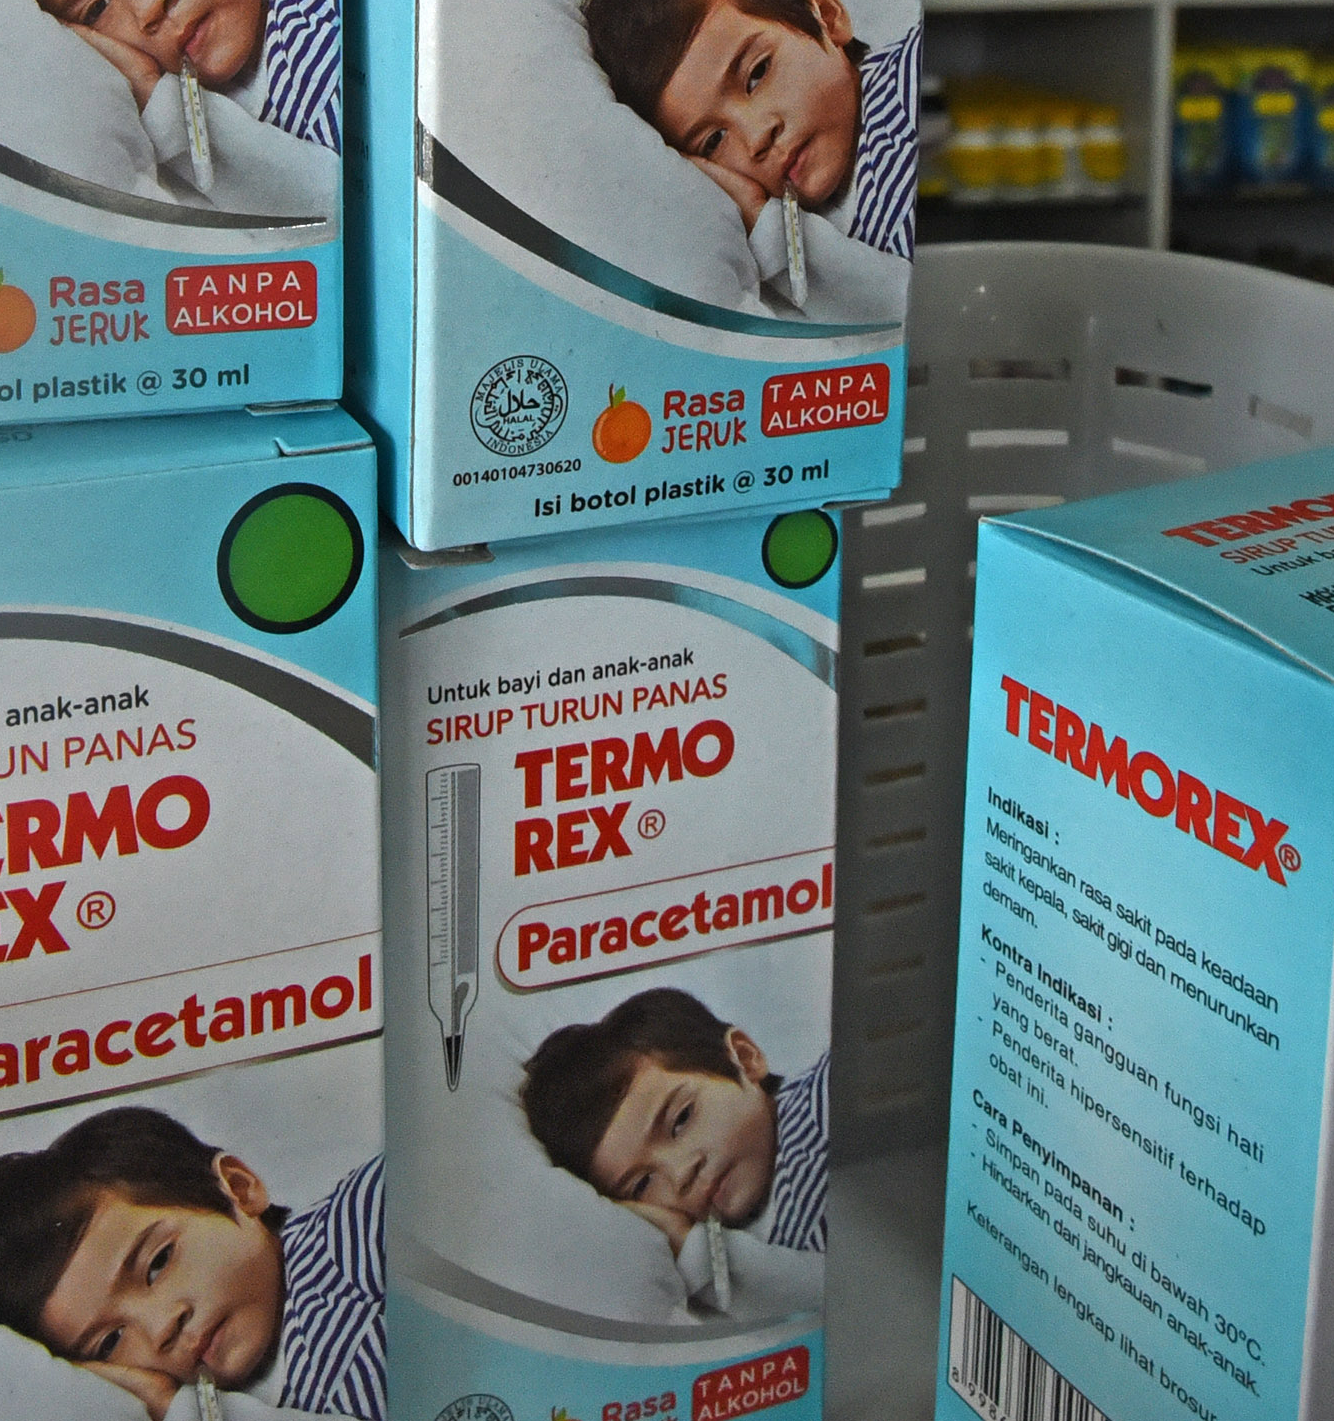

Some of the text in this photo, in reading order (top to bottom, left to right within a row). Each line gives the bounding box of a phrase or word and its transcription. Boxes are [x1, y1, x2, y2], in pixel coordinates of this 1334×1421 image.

[49, 276, 145, 308] Rasa
[173, 270, 301, 296] TANPA
[49, 309, 150, 346] JERUK
[173, 300, 312, 327] ALKOHOL
[33, 372, 126, 403] plastik
[136, 370, 162, 396] @
[172, 367, 207, 389] 30
[217, 363, 249, 387] ml
[475, 358, 564, 402] MAJELIS ULAMA
[769, 372, 876, 402] TANPA
[502, 414, 535, 425] HALAL
[663, 389, 744, 420] Rasa
[767, 399, 887, 431] ALKOHOL
[486, 429, 554, 455] INDONESIA
[661, 417, 746, 453] JERUK
[452, 458, 581, 486] 00140104730620
[534, 459, 828, 517] Isi botol plastik @ 30 ml
[1220, 534, 1299, 565] SIRUP
[428, 647, 693, 704] Untuk bayi dan anak-anak
[5, 684, 149, 727] anak-anak
[426, 673, 727, 745] SIRUP TURUN PANAS
[64, 718, 196, 768] PANAS
[514, 719, 734, 808] TERMO
[988, 786, 1048, 838] Indikasi
[518, 862, 832, 972] Paracetamol
[986, 816, 1278, 1013] Meringankan rasa sakit pada keadaan
[985, 851, 1015, 882] sakit
[1072, 908, 1105, 941] sakit
[1107, 931, 1133, 961] gigi
[1135, 949, 1166, 980] dan
[1170, 971, 1279, 1050] menurunkan
[981, 923, 1101, 1023] Kontra Indikasi
[993, 992, 1029, 1033] yang
[989, 1053, 1022, 1088] obat
[995, 960, 1263, 1163] Penderita gangguan fungsi hati
[992, 1019, 1266, 1235] Penderita hipersensitif terhadap
[973, 1088, 1123, 1222] Cara Penyimpanan
[982, 1154, 1050, 1225] Hindarkan
[1053, 1219, 1080, 1251] dari
[1082, 1239, 1162, 1319] jangkauan
[985, 1127, 1208, 1322] Simpan pada suhu di bawah
[967, 1200, 1154, 1377] Keterangan lengkap lihat
